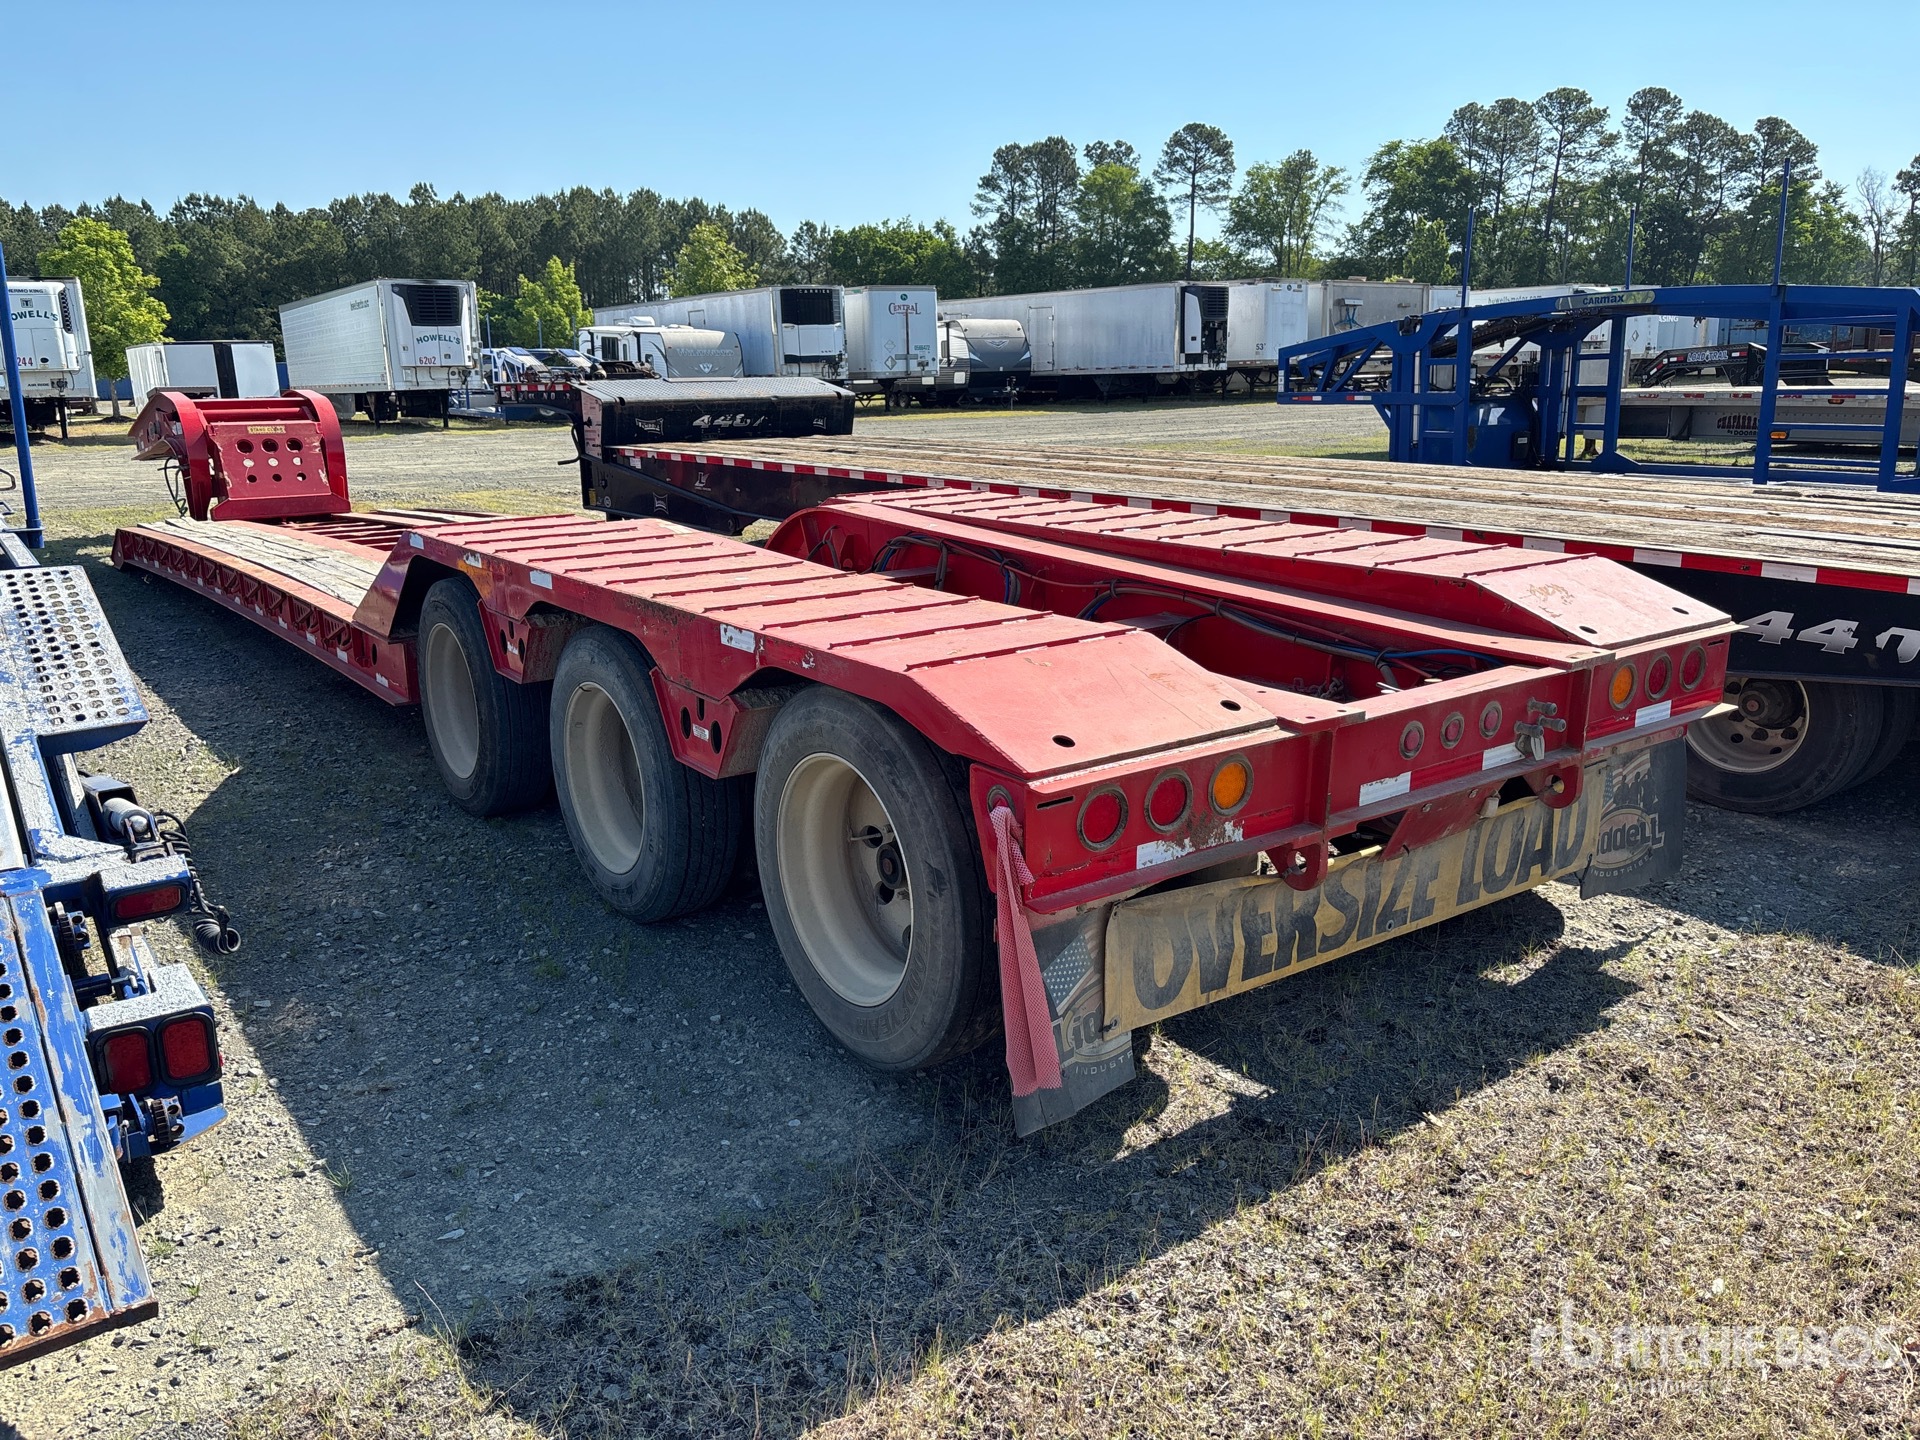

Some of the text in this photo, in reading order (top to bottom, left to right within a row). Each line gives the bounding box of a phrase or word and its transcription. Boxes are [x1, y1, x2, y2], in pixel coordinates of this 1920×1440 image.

[10, 309, 59, 322] OWELL'S
[416, 334, 461, 345] HOWELL'S
[17, 357, 33, 367] 244
[1687, 350, 1729, 362] LOAD TRAIL
[1717, 415, 1758, 430] CHAPARRA
[1133, 797, 1588, 1010] OVERSIZE LOAD
